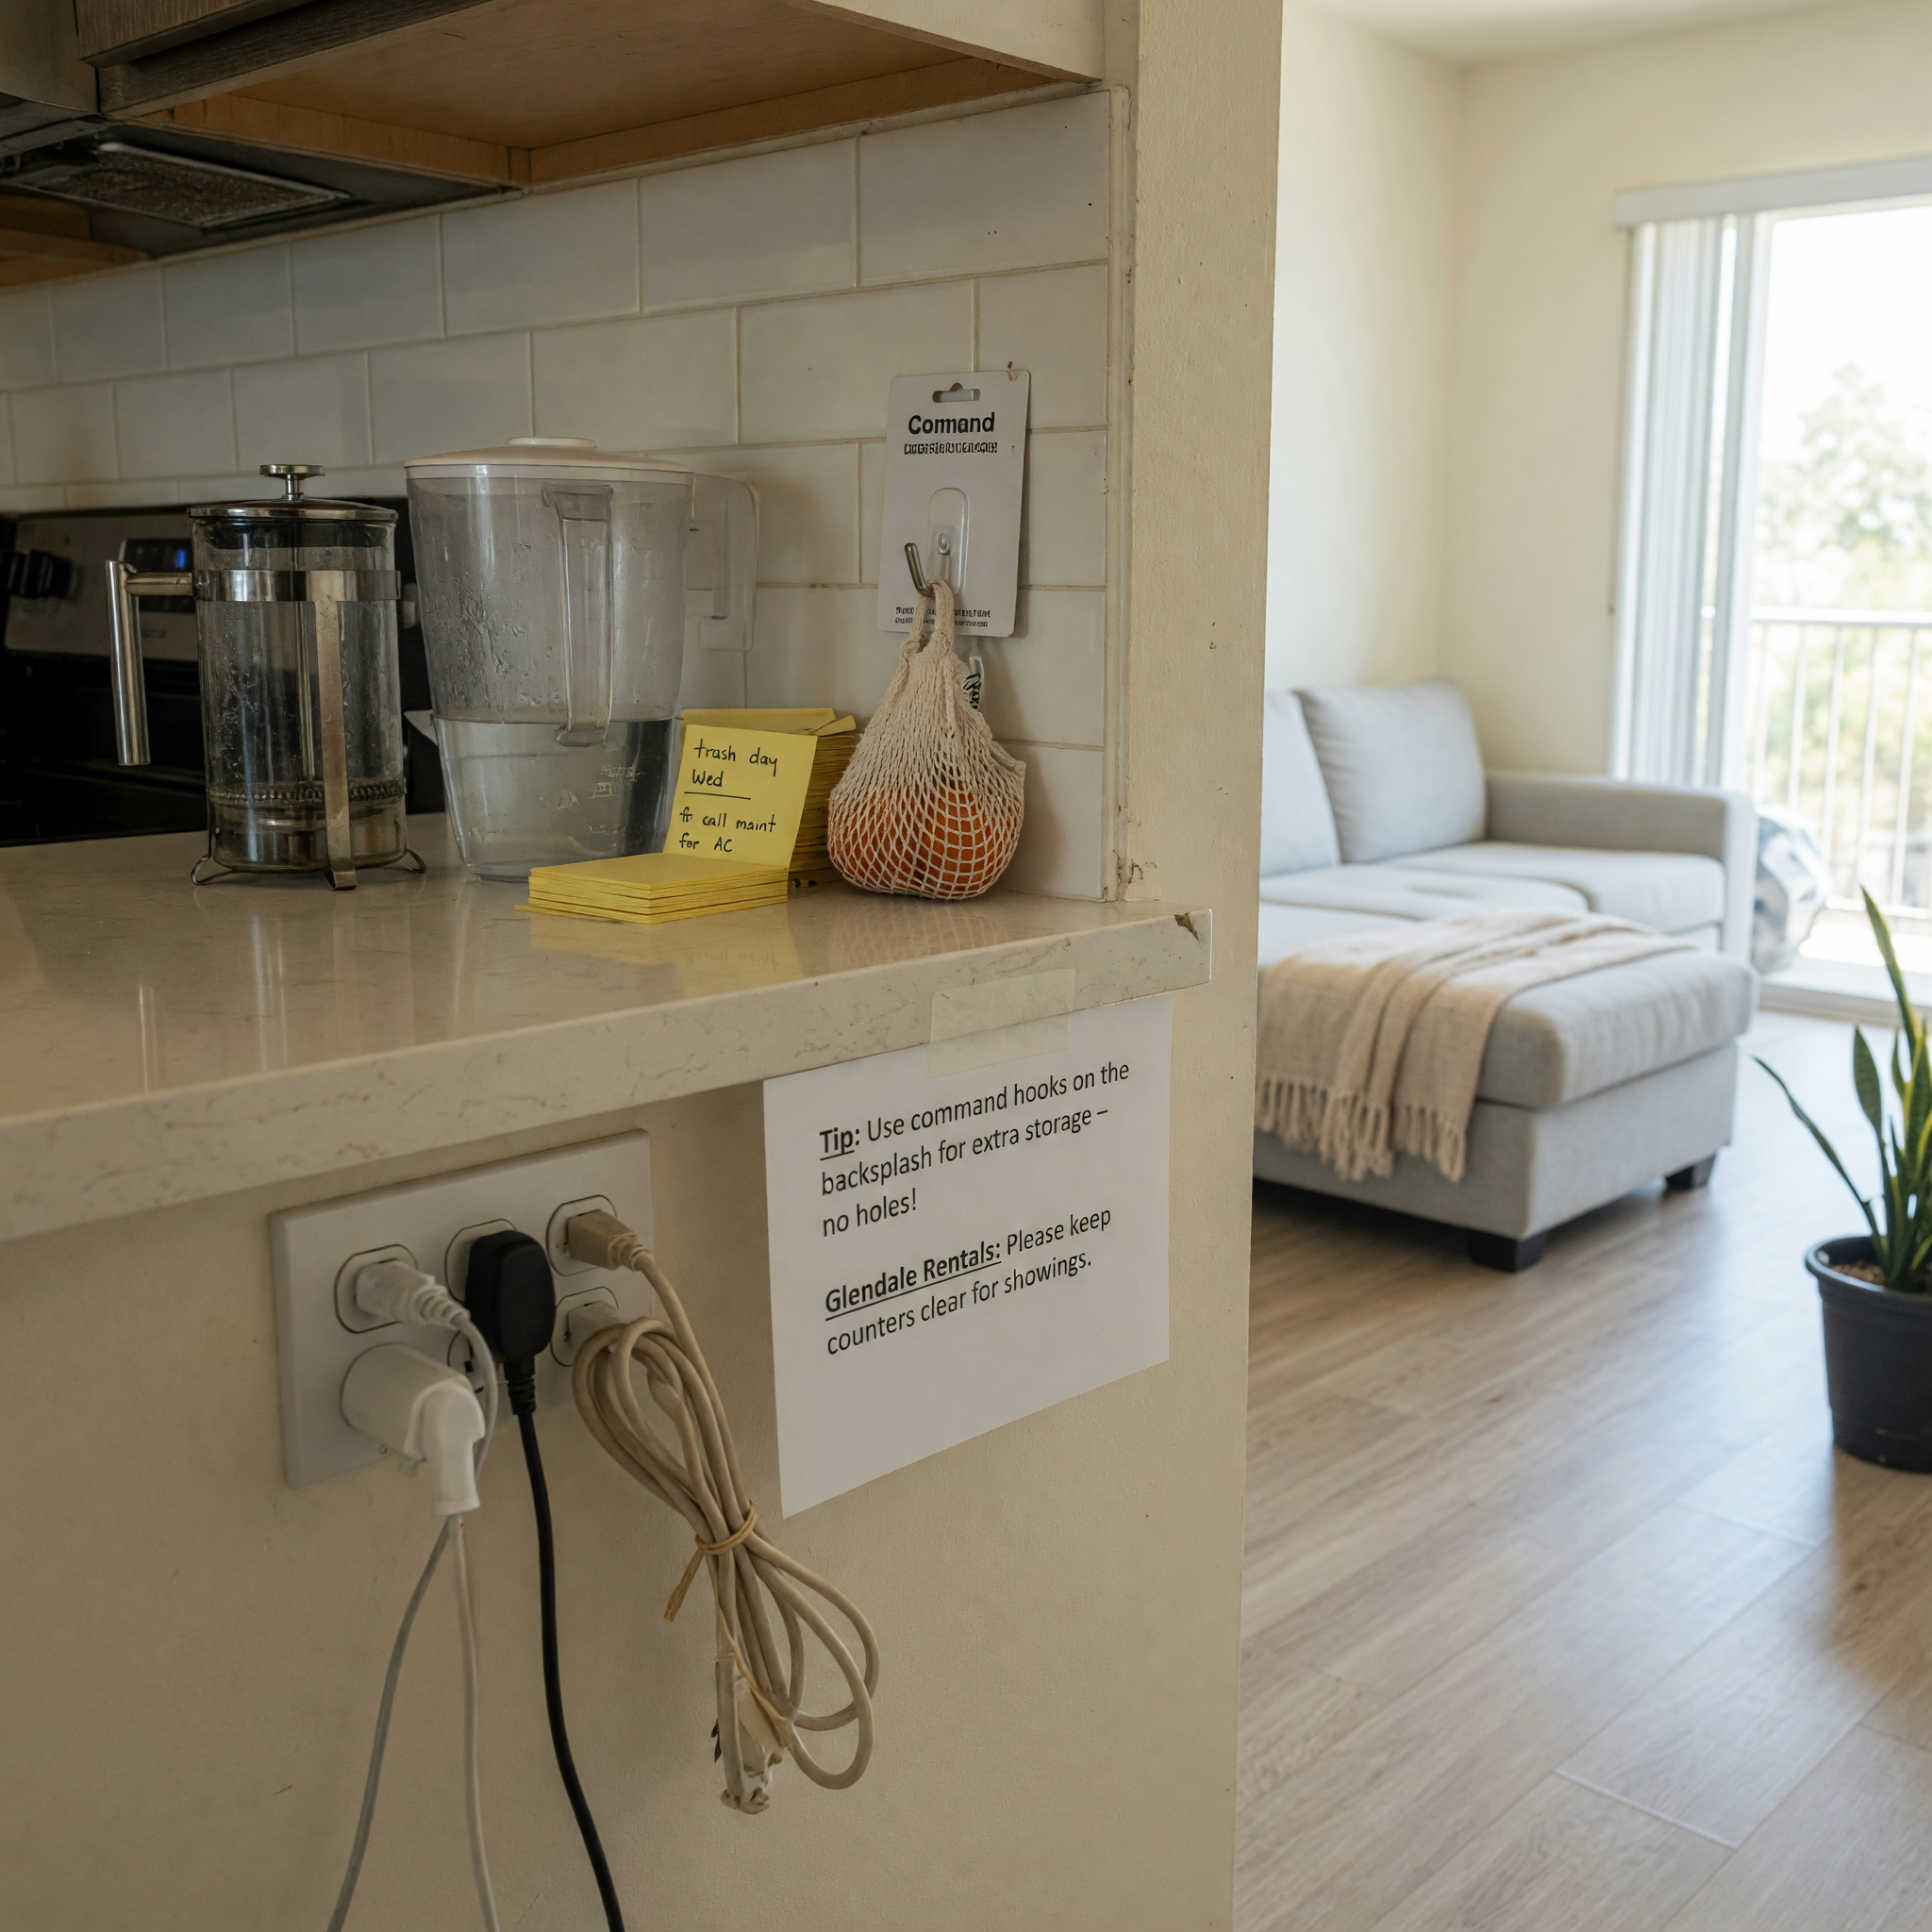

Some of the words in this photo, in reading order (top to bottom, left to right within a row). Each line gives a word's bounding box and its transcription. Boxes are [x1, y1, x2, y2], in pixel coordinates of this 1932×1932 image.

[691, 768, 724, 788] Wed
[692, 738, 737, 762] trash
[748, 747, 778, 777] day
[678, 831, 700, 850] for
[713, 836, 733, 853] AC
[702, 812, 727, 828] call
[735, 813, 777, 833] maint
[819, 1126, 860, 1161] Tip:
[867, 1117, 905, 1142] Use
[910, 1085, 1008, 1131] command
[1014, 1074, 1068, 1107] hooks
[1073, 1072, 1095, 1091] on
[1100, 1060, 1129, 1085] the
[822, 1144, 932, 1196] backsplash
[938, 1139, 967, 1164] for
[972, 1127, 1020, 1156] extra
[1024, 1108, 1092, 1141] storage
[823, 1214, 850, 1238] no
[856, 1187, 917, 1227] holes!
[824, 1265, 918, 1322] Glendale
[923, 1241, 1002, 1290] Rentals:
[1007, 1223, 1065, 1256] Please
[1070, 1209, 1111, 1237] keep
[827, 1309, 915, 1356] counters
[921, 1291, 967, 1322] clear
[971, 1280, 999, 1305] for
[1004, 1252, 1091, 1294] showings.
